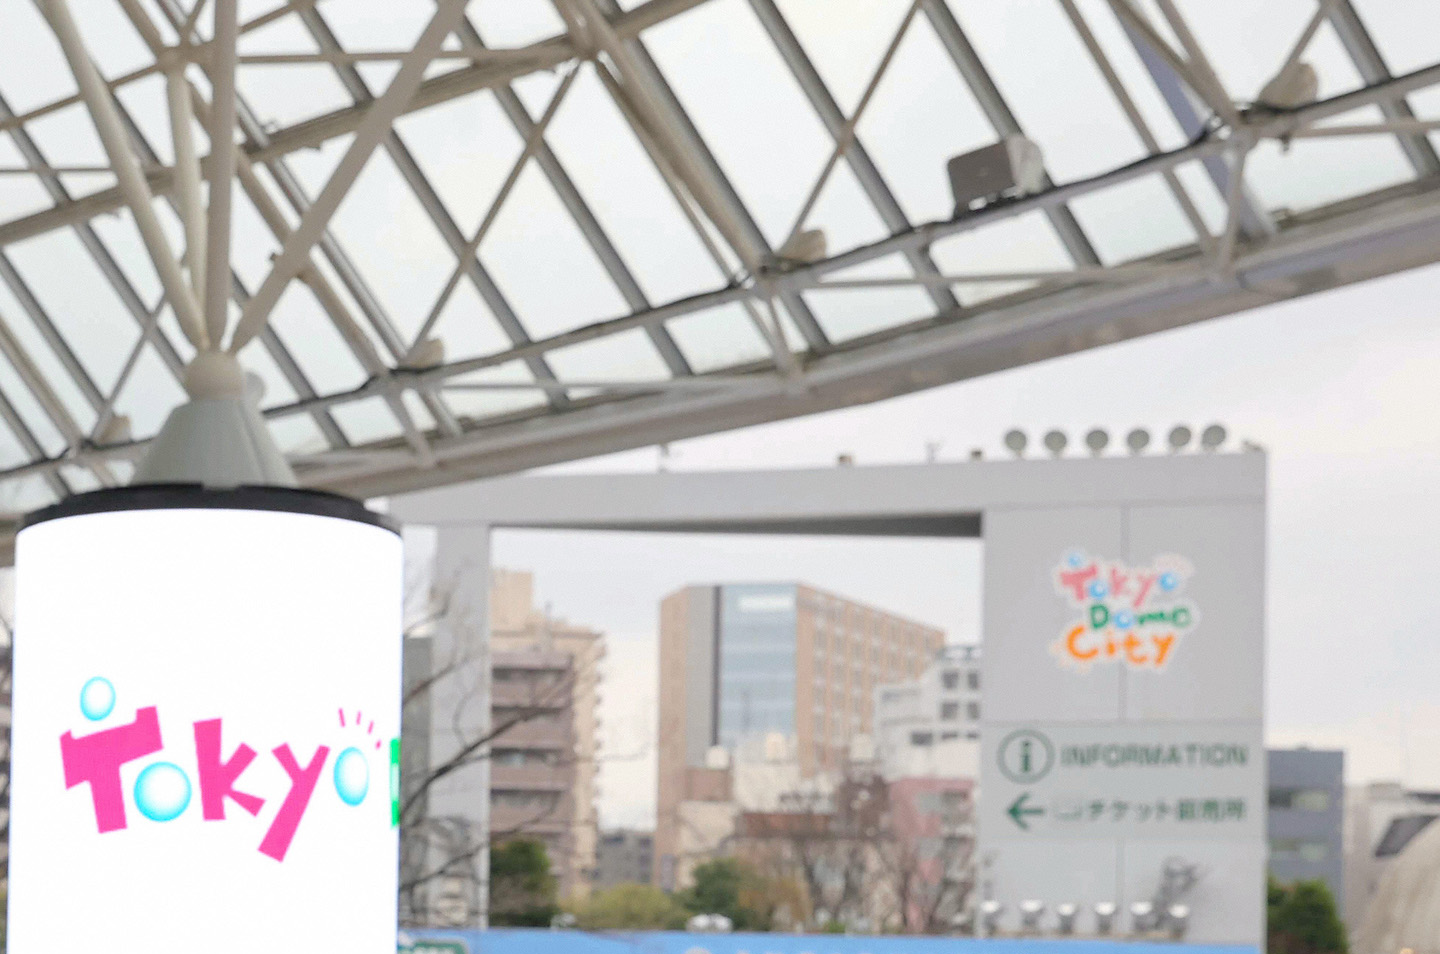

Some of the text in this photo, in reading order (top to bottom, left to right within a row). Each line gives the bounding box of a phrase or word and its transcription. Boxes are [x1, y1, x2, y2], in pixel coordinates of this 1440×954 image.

[1060, 560, 1179, 608] Tokyo
[1065, 625, 1175, 667] City
[1061, 743, 1248, 767] INFORMATION
[60, 703, 369, 863] Tokyo
